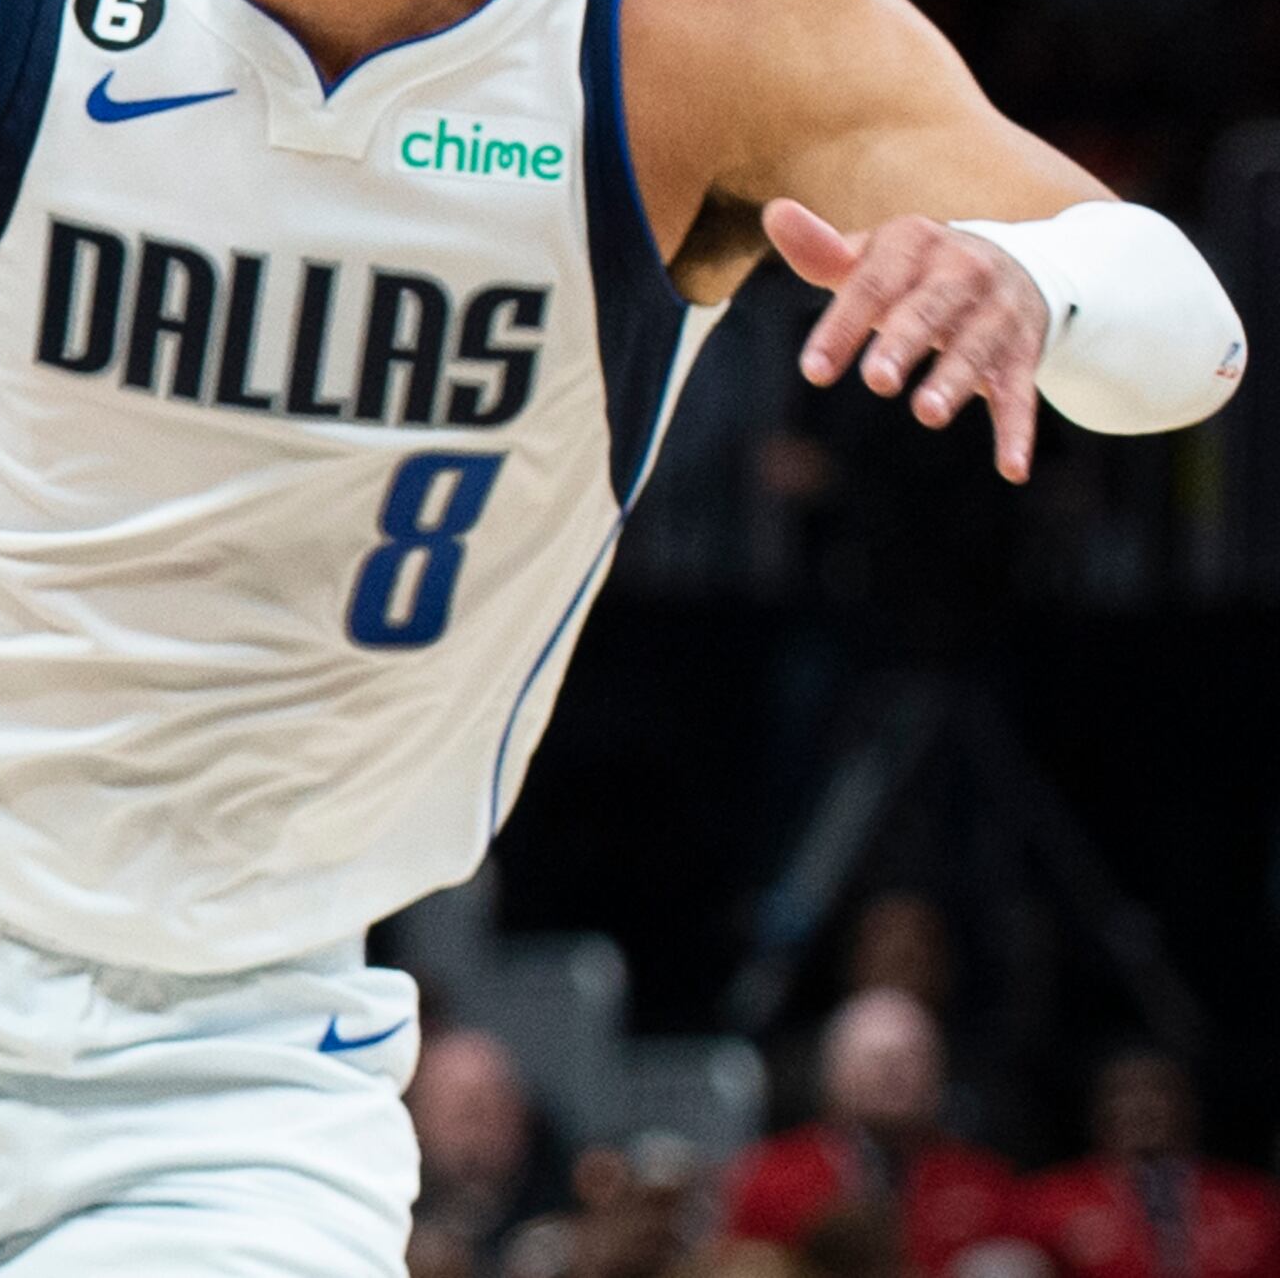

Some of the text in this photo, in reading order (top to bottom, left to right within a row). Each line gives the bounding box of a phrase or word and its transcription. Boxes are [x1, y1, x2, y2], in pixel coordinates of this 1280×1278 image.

[401, 120, 564, 181] chime
[34, 218, 550, 429] DALLAS
[344, 450, 506, 651] 8
